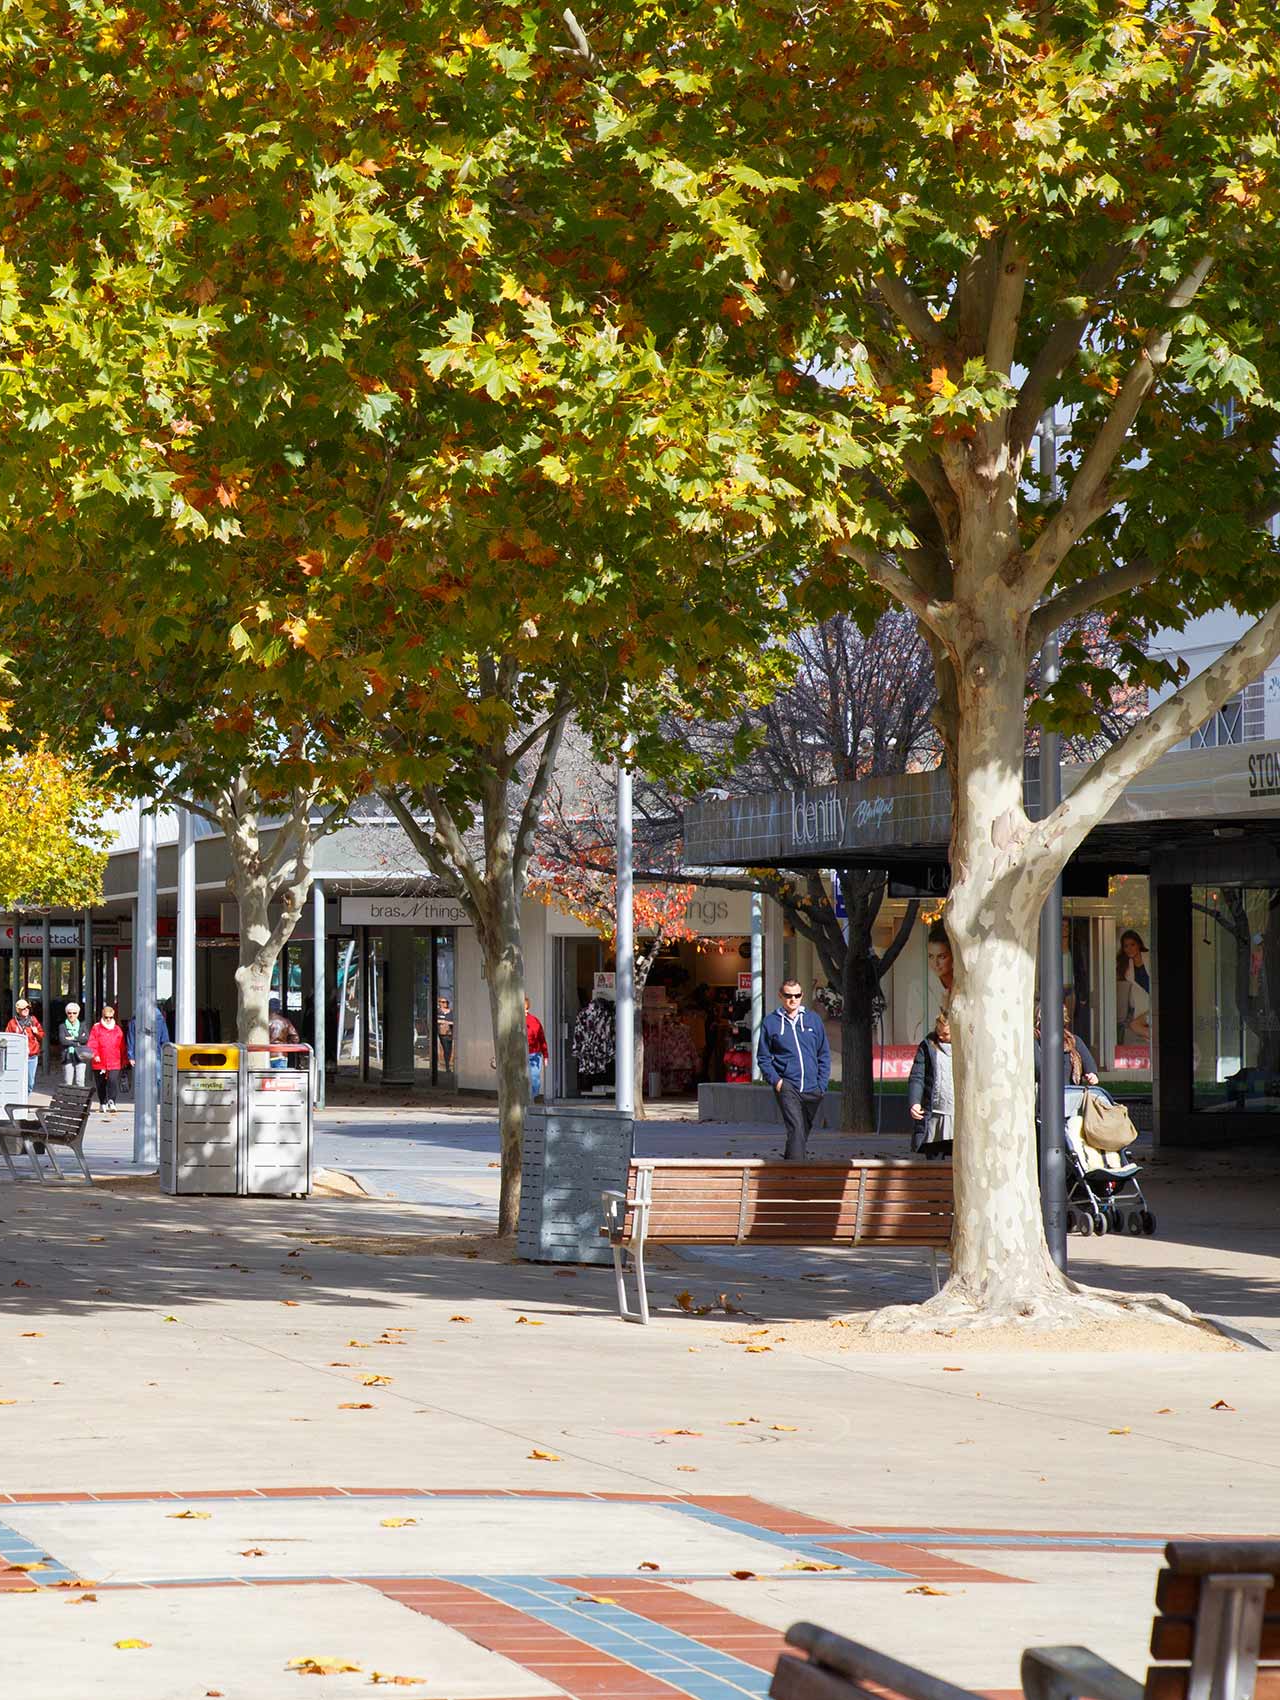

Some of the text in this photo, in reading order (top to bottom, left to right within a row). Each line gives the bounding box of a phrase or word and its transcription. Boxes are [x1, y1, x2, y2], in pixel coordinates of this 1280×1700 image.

[792, 786, 848, 848] Identity
[370, 903, 400, 918] bras
[425, 904, 466, 921] things
[19, 932, 80, 944] rice ttack
